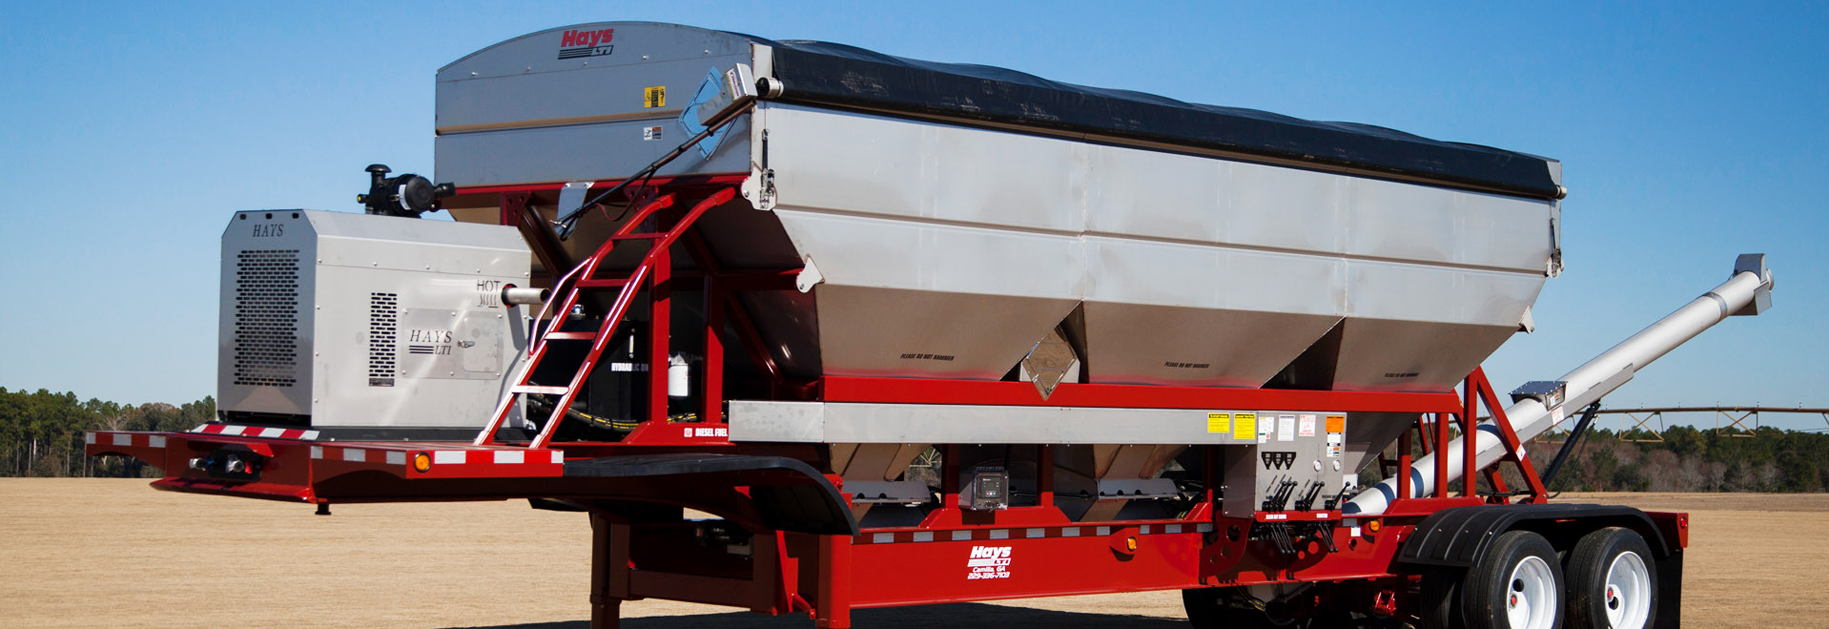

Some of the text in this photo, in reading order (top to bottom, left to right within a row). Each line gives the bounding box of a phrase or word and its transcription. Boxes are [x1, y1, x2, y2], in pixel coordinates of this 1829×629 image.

[561, 28, 614, 47] Hays
[252, 223, 284, 237] HAYS
[476, 280, 501, 292] HOT
[409, 329, 453, 344] HAYS
[434, 345, 452, 355] LTI
[695, 427, 729, 437] DIESEL FUEL
[970, 545, 1012, 560] Hays
